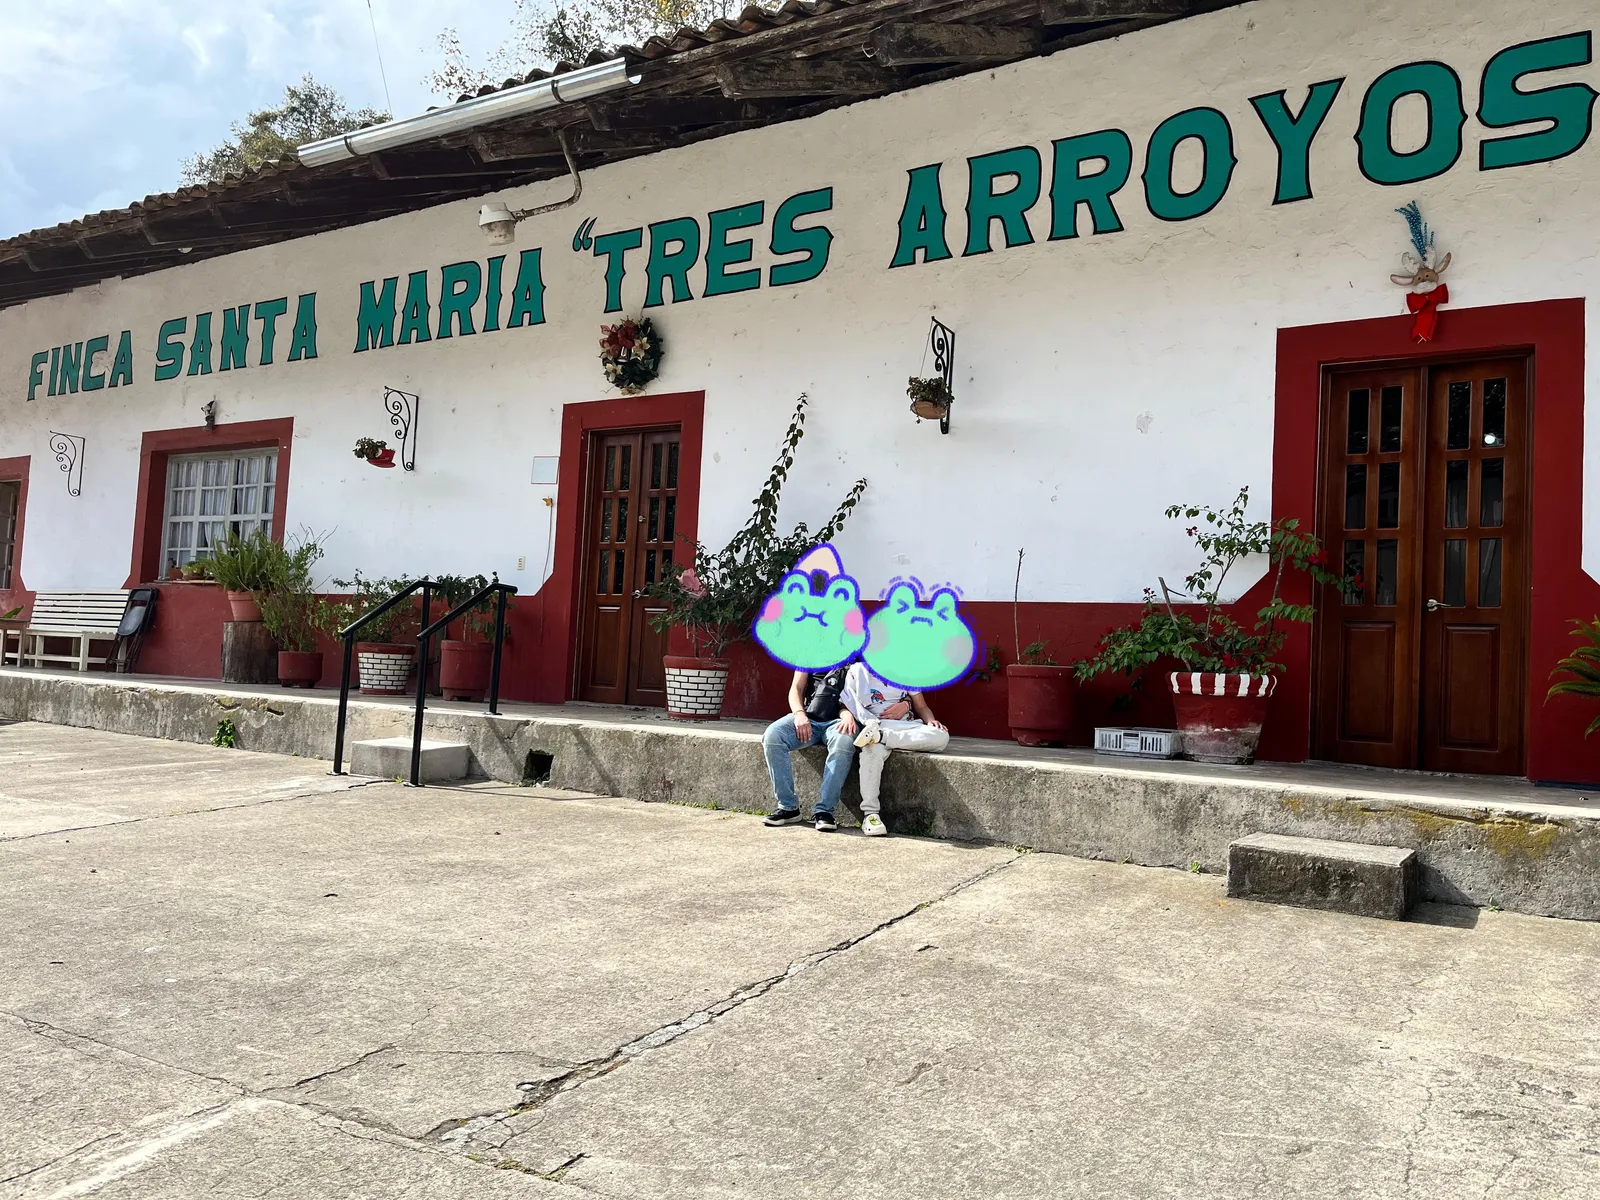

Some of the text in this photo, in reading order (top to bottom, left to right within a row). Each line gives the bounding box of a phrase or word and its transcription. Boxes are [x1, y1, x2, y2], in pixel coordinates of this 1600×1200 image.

[27, 330, 133, 401] FINCA
[154, 292, 319, 381] SANTA
[353, 247, 547, 353] MARIA
[889, 30, 1599, 269] ARROYOS
